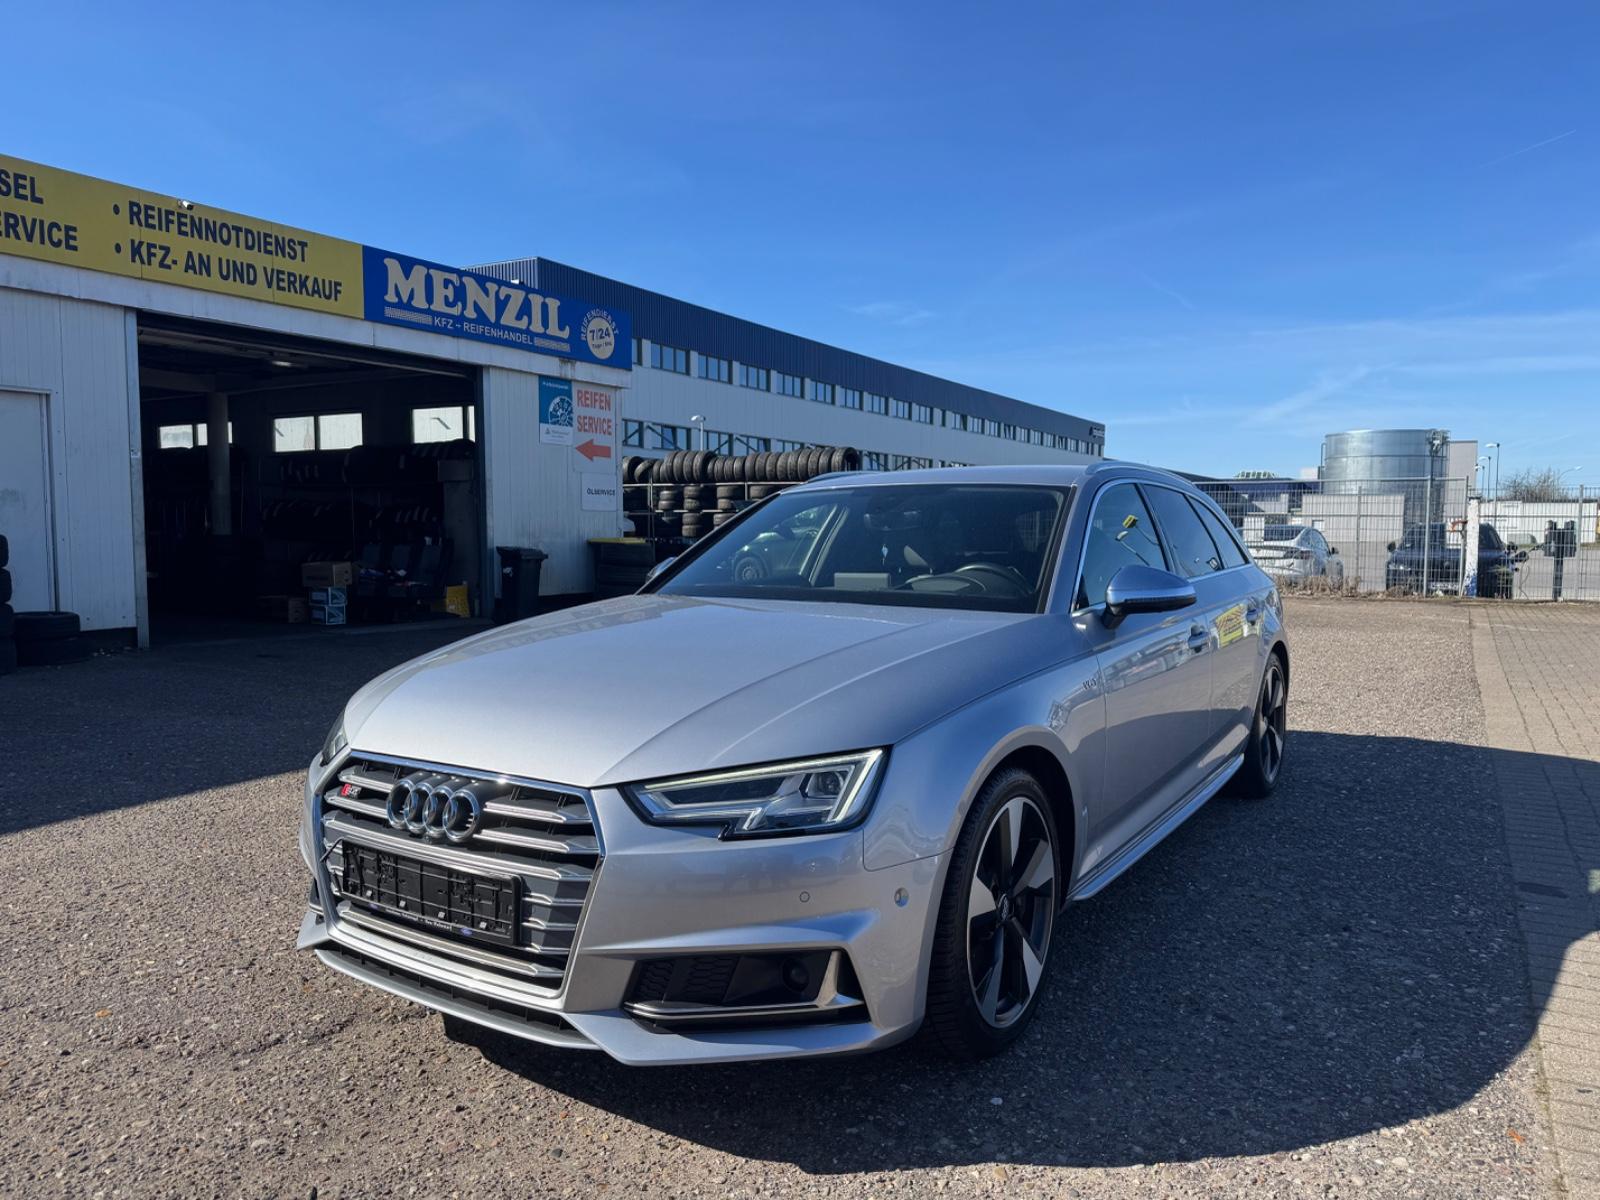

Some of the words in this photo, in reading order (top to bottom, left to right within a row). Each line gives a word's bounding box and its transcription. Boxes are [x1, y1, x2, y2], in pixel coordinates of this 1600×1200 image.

[0, 210, 78, 252] RVICE
[128, 200, 308, 263] REIFENNOTDIENST
[130, 239, 178, 270] KFZ-
[184, 251, 211, 278] AN
[218, 258, 257, 286] UND
[263, 267, 343, 302] VERKAUF
[383, 257, 570, 340] MENZIL
[434, 316, 454, 329] KFZ
[463, 322, 533, 345] REIFENHANDEL
[576, 389, 611, 412] REIFEN
[576, 415, 613, 436] SERVICE
